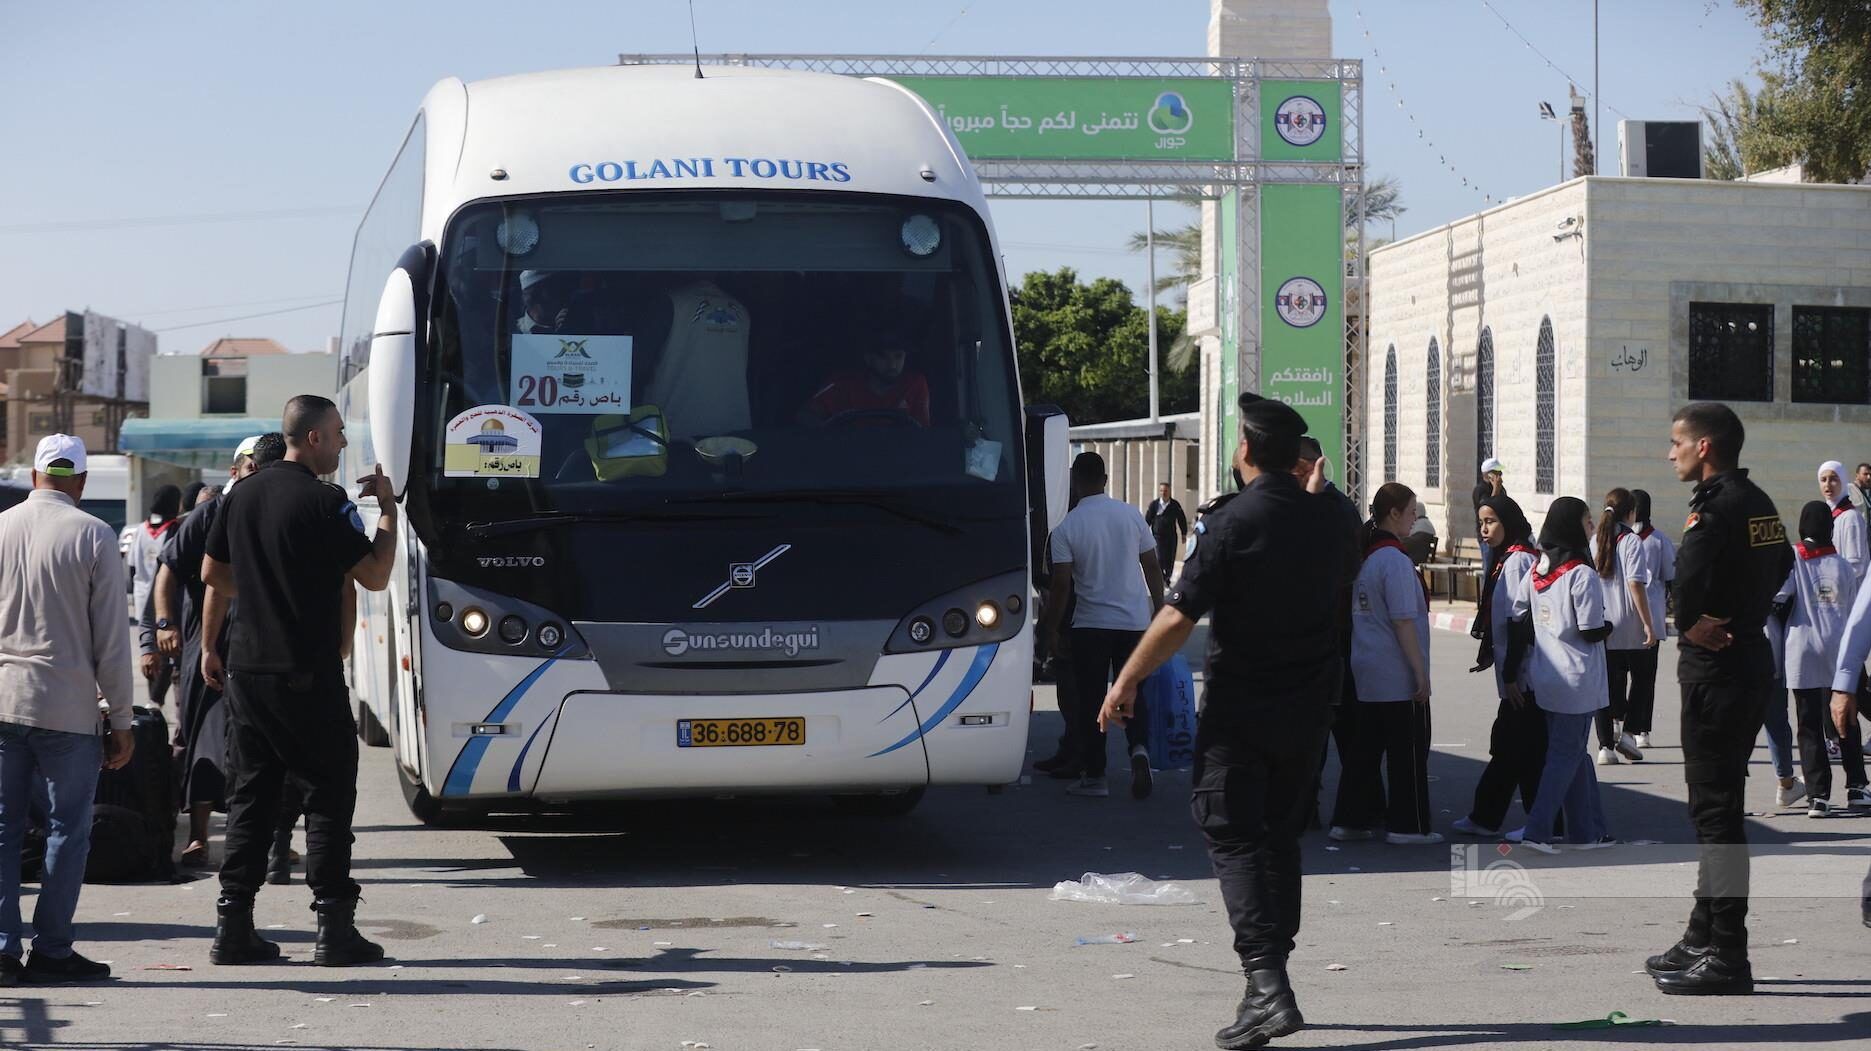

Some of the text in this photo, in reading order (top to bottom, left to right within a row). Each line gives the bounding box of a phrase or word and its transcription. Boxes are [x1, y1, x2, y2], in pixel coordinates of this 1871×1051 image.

[1038, 111, 1076, 135] لكم
[1082, 112, 1139, 135] نتمنى
[1154, 136, 1186, 149] جوال
[568, 157, 852, 184] GOLANI TOURS
[1611, 345, 1648, 372] الوهاب
[1270, 367, 1332, 386] رافقتكم
[517, 375, 621, 407] باص رقم 20
[503, 460, 521, 472] باص
[1751, 520, 1785, 542] POLICE
[476, 556, 545, 568] VOLVO
[662, 626, 818, 656] Sunsundegui
